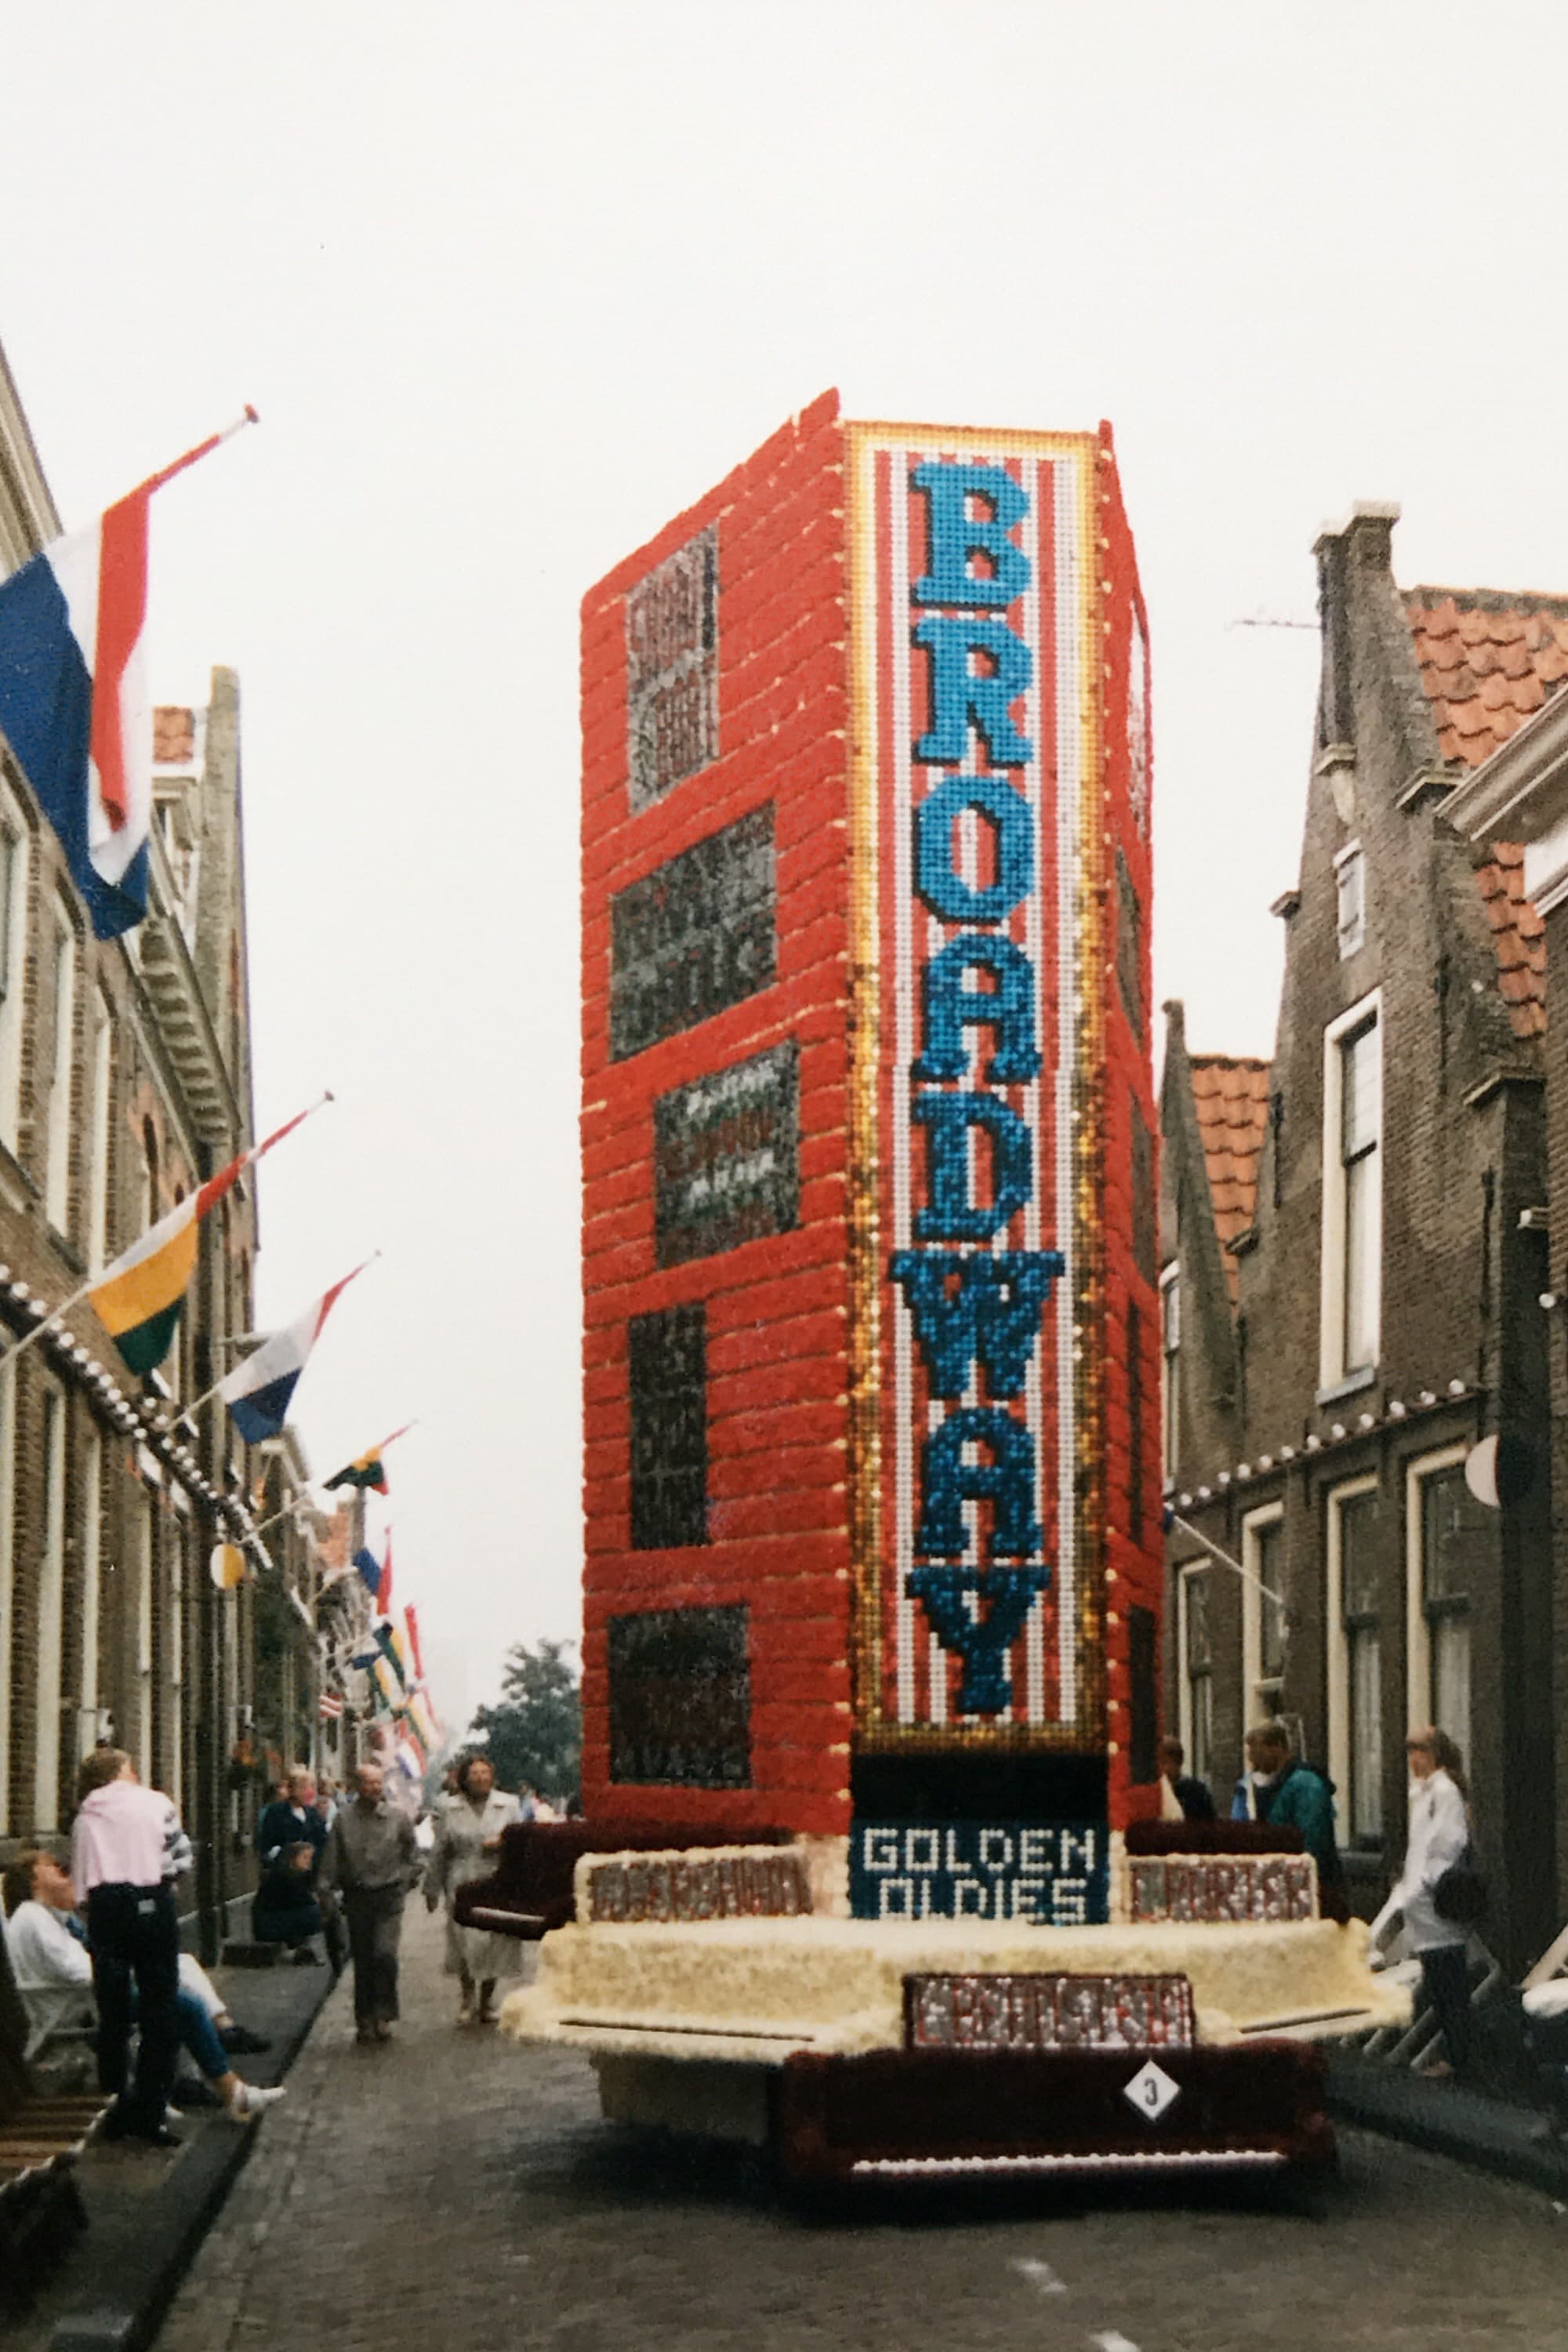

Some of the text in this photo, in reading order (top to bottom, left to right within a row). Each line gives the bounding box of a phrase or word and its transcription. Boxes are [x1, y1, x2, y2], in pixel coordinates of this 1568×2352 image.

[887, 461, 1065, 1715] BROADWAY
[863, 1828, 1095, 1872] GOLDEN
[879, 1878, 1087, 1923] OLDIES
[1144, 2077, 1158, 2107] 3
